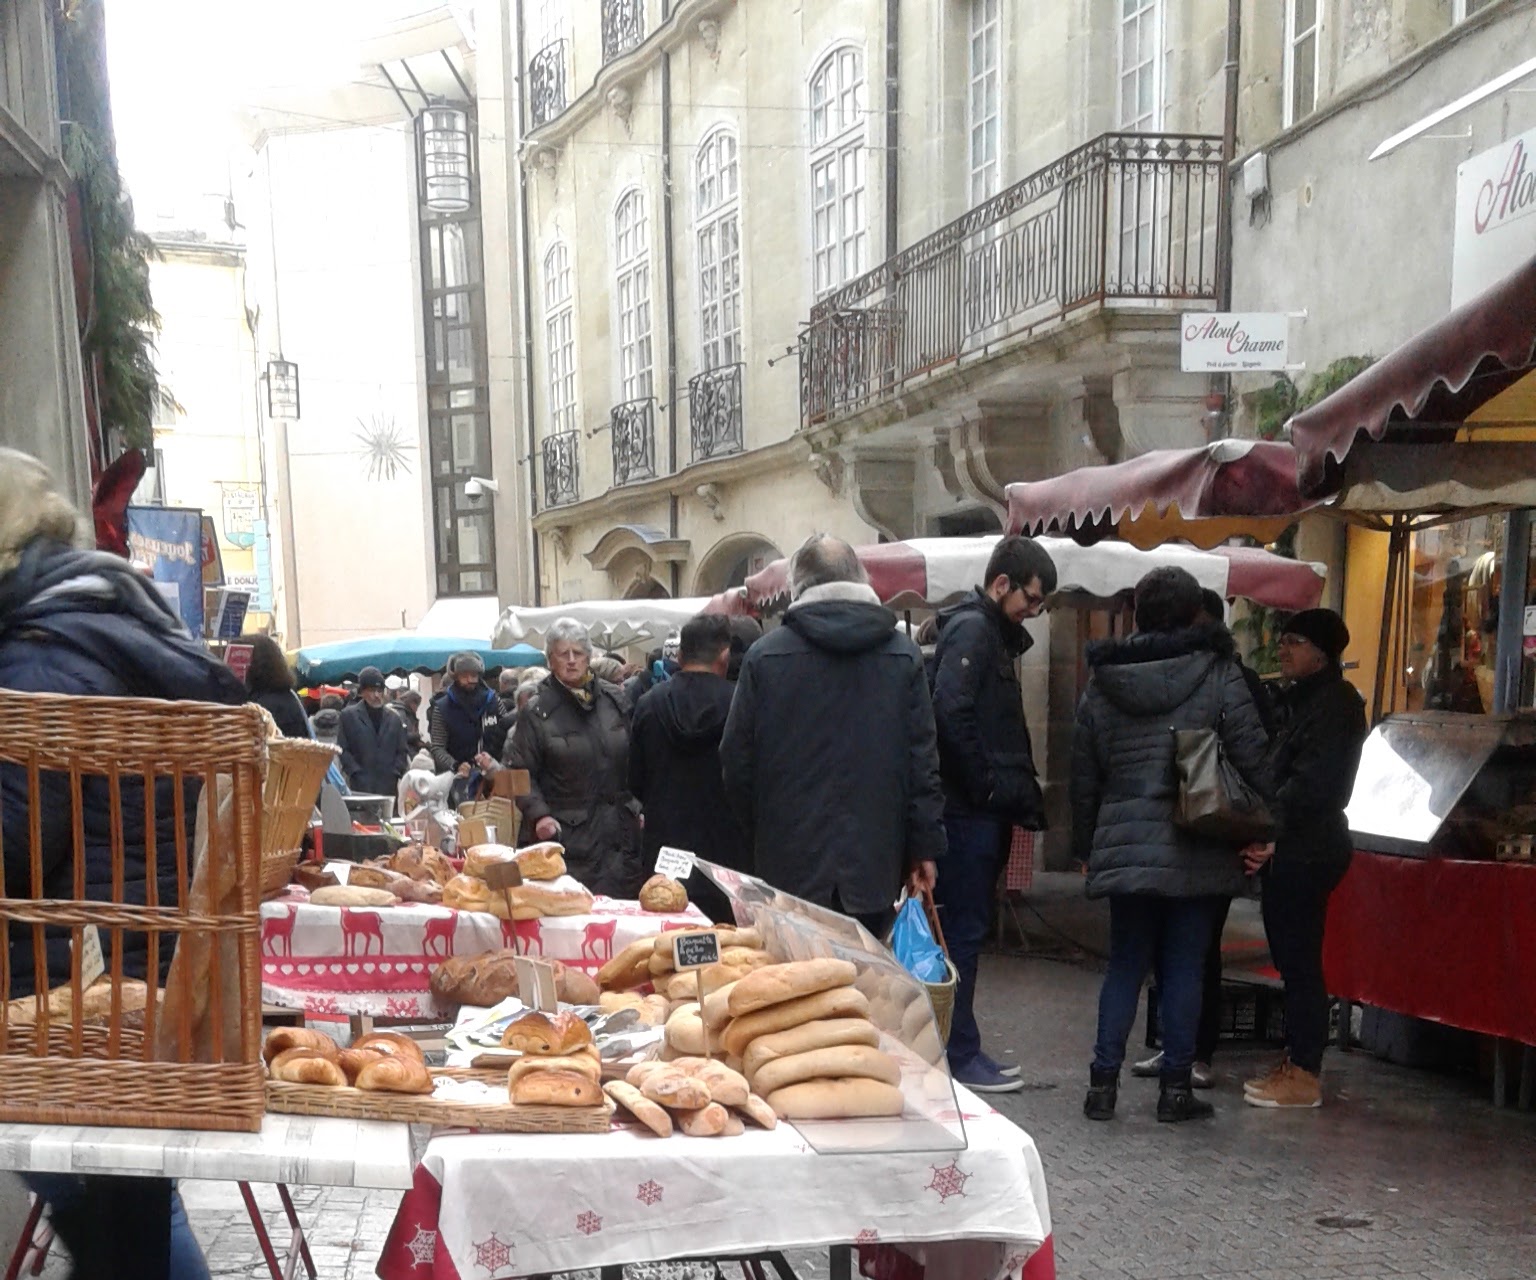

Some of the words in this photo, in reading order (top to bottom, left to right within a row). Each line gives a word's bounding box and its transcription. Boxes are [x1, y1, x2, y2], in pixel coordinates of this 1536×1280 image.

[1475, 138, 1536, 234] Ato
[1184, 316, 1241, 342] Atout
[1226, 329, 1284, 355] Charme
